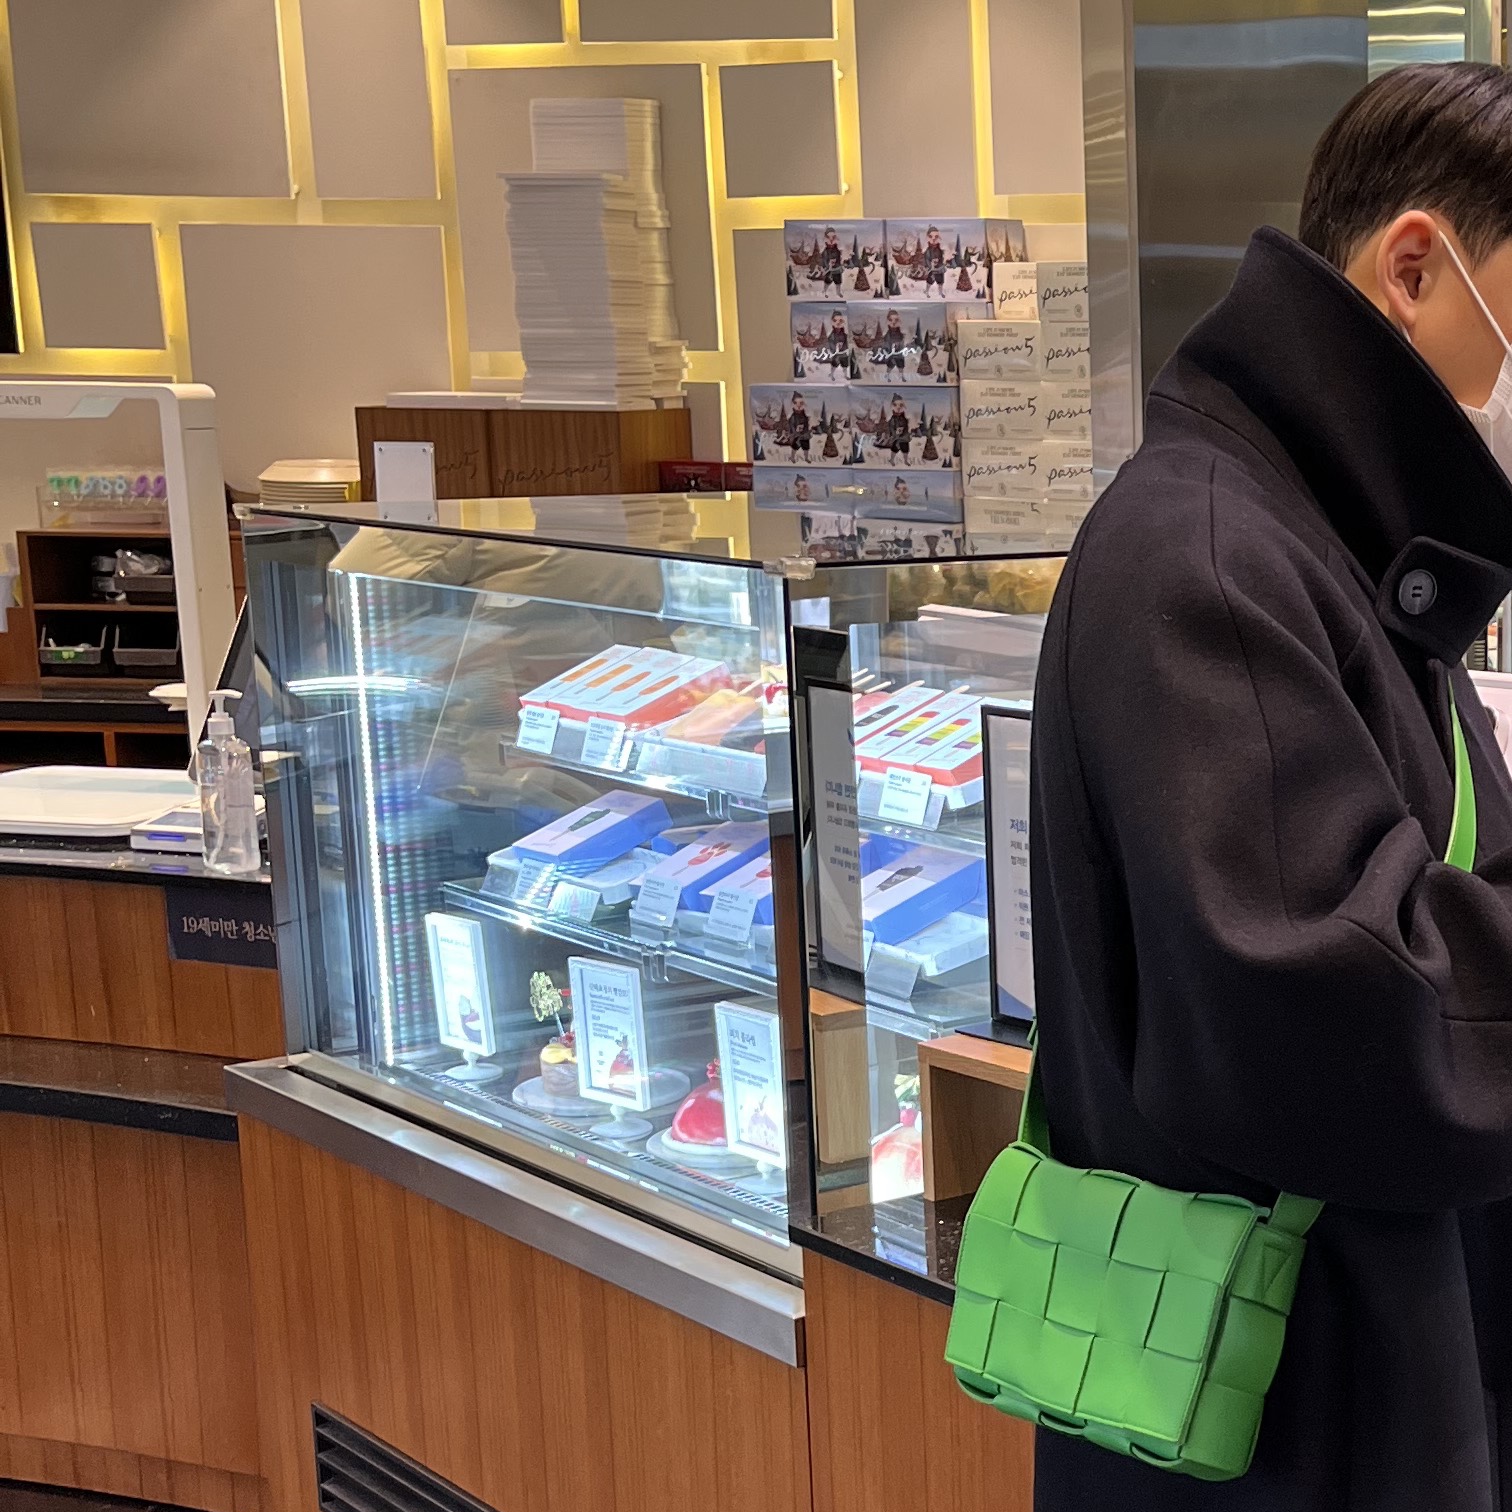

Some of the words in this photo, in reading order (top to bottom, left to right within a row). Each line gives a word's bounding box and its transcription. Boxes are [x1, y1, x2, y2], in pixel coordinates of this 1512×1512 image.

[999, 287, 1037, 310] passi
[799, 342, 850, 372] passi
[182, 916, 239, 939] 19세미만
